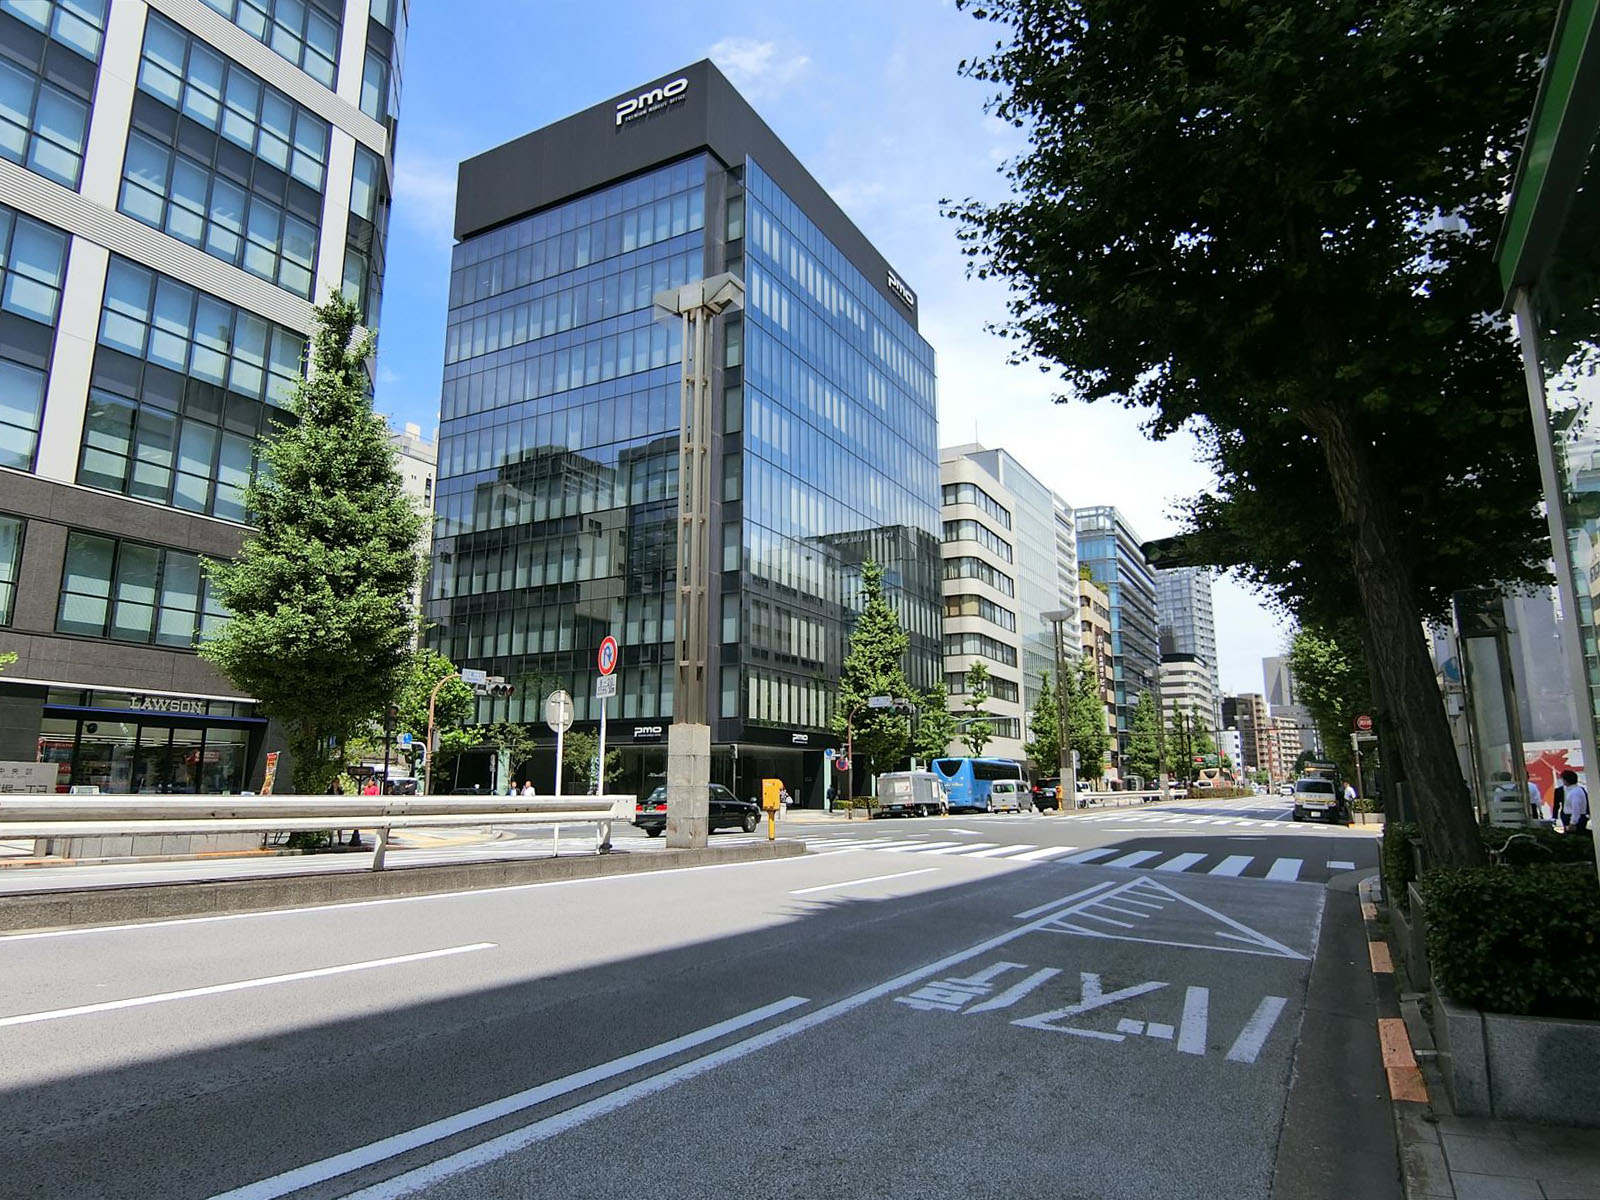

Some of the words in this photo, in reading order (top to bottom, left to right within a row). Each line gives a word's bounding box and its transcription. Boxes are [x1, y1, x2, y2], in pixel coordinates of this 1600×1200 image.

[615, 78, 689, 126] pmo
[887, 270, 914, 305] pmo
[129, 697, 203, 713] LAWSON
[634, 726, 662, 738] pmo
